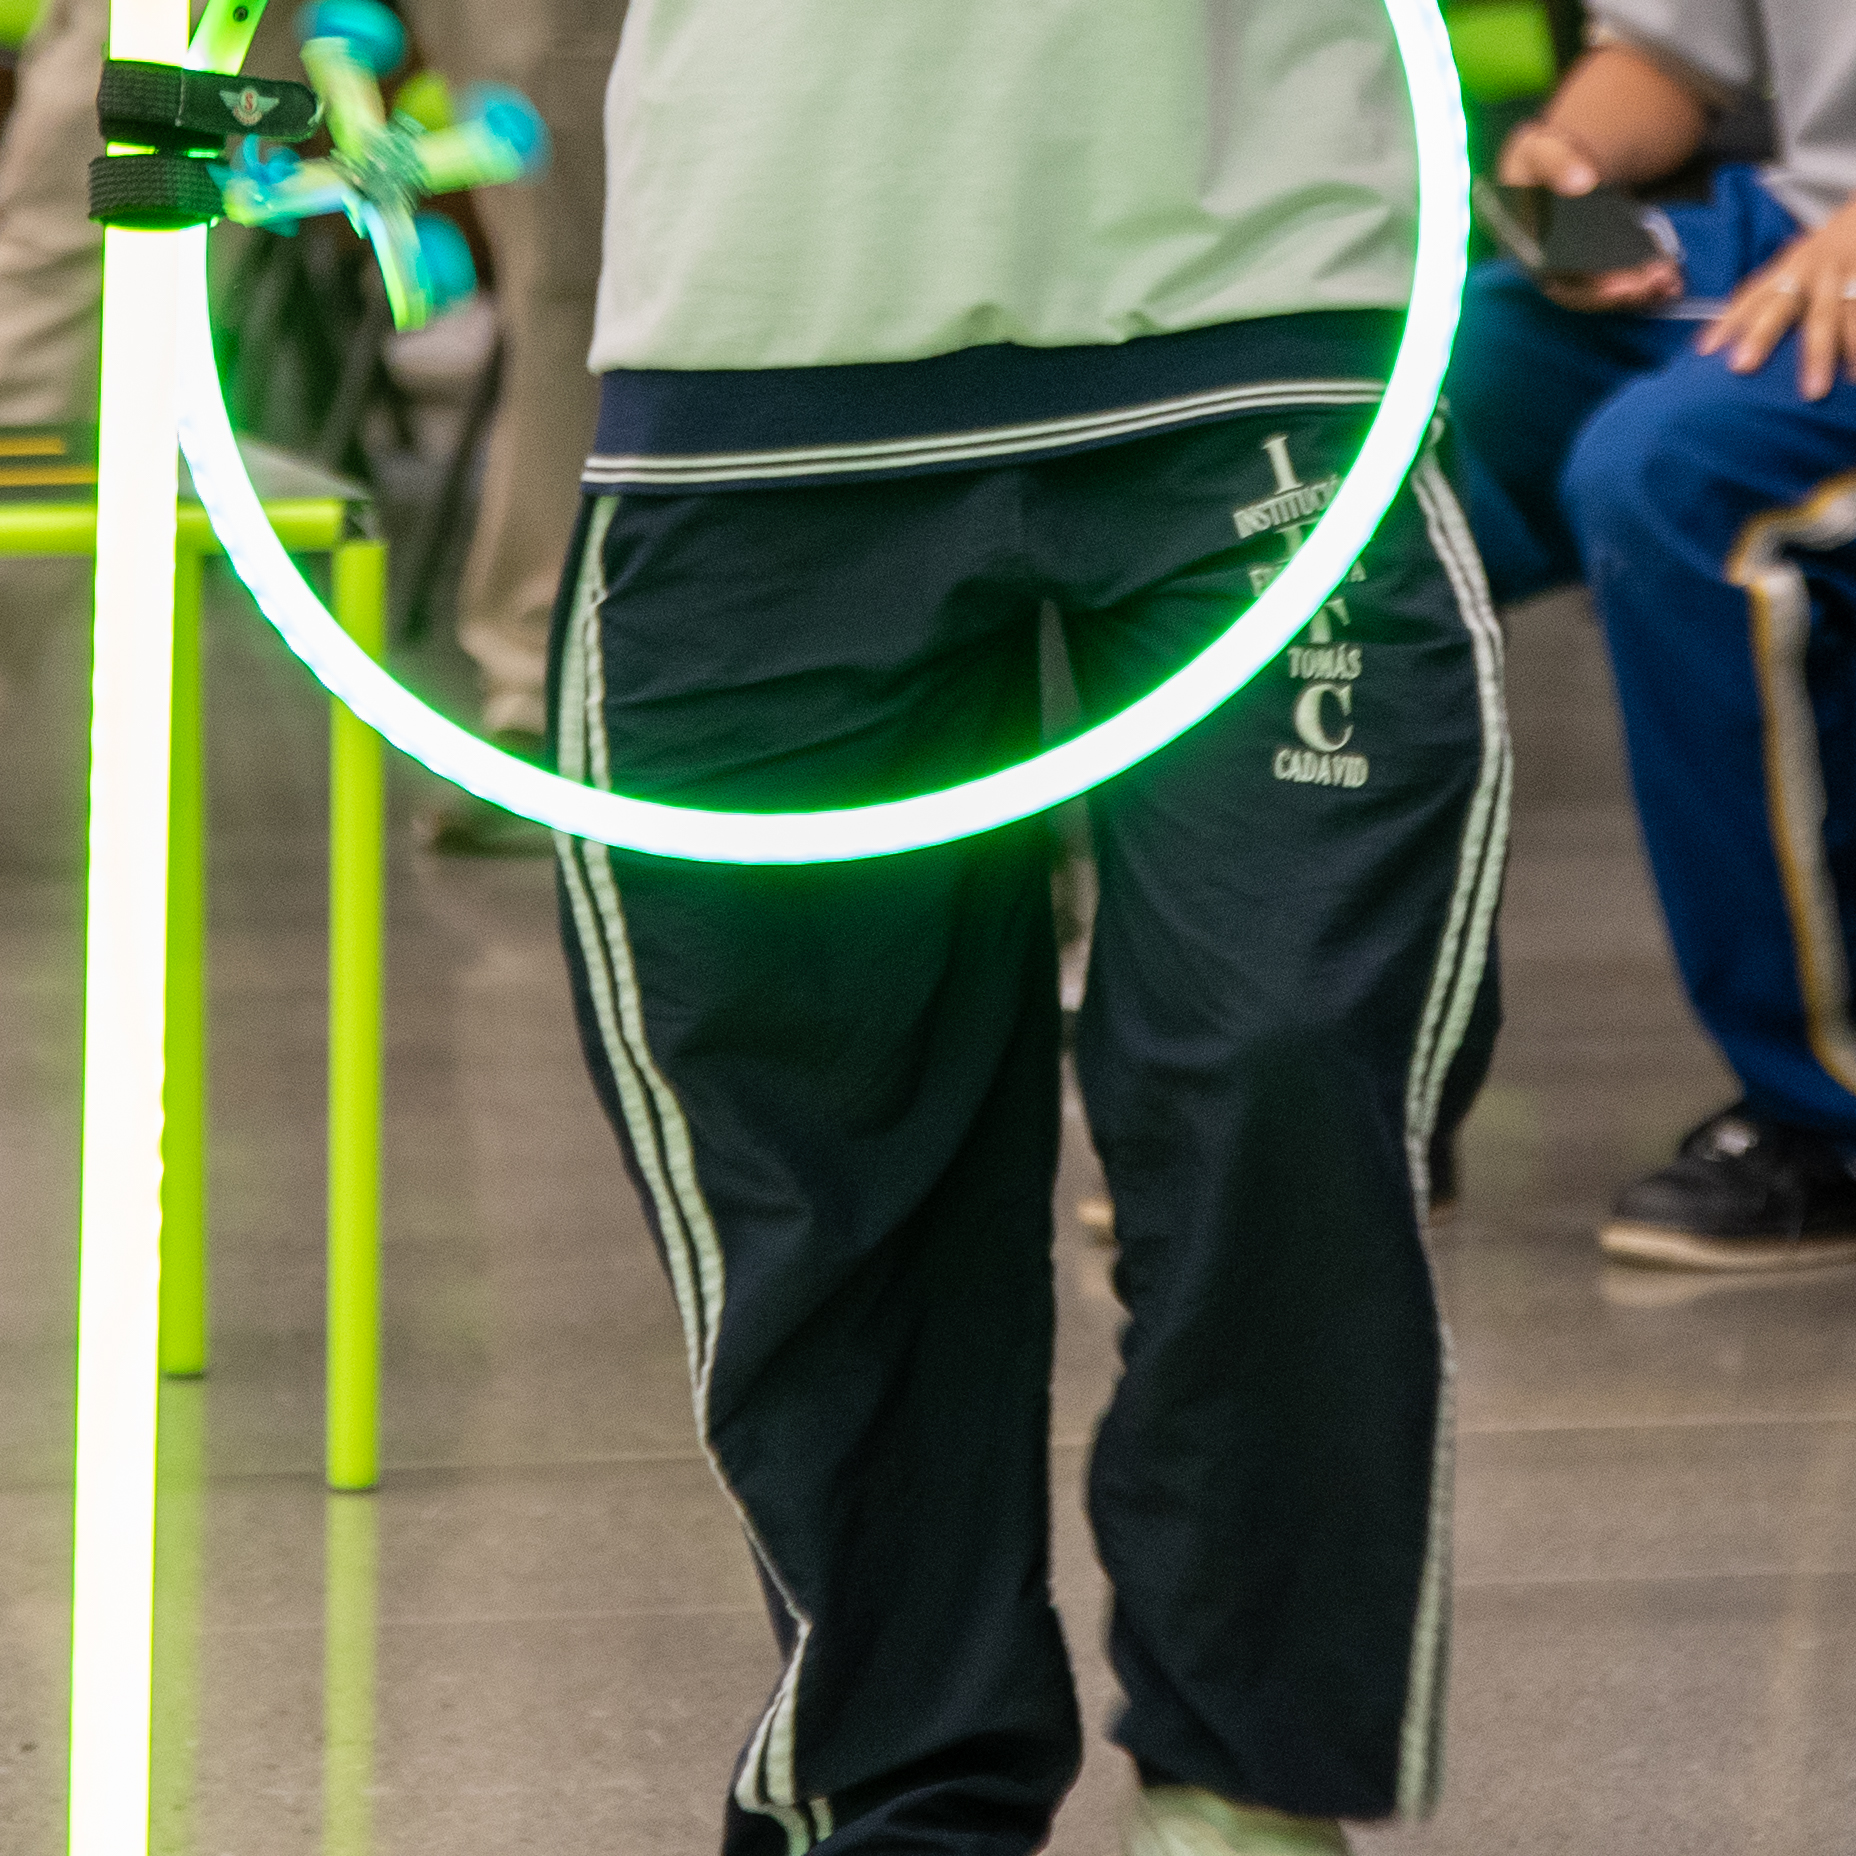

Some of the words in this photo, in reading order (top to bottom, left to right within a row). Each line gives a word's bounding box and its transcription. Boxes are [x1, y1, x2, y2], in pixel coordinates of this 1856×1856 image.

[1263, 434, 1304, 494] I
[1233, 472, 1342, 540] INSTITUC
[1287, 643, 1362, 681] TOMÁS
[1294, 682, 1353, 753] C
[1273, 748, 1370, 789] CADAVID
